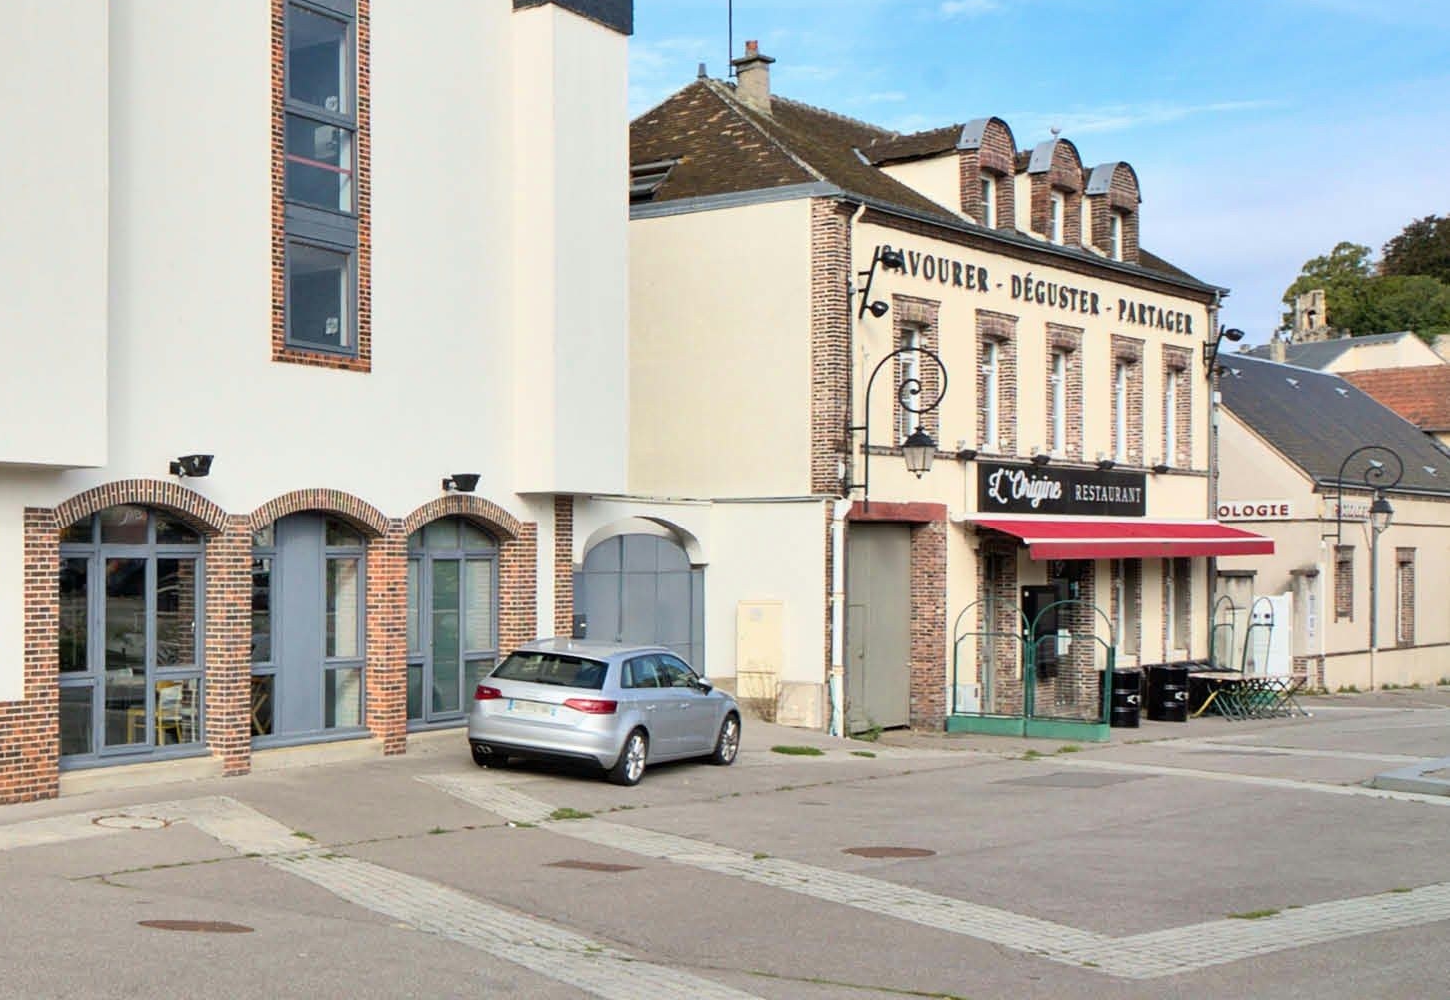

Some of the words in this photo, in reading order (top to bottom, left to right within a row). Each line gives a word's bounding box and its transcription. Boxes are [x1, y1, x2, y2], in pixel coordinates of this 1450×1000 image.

[1011, 272, 1100, 315] DÉGUSTER
[1118, 299, 1193, 335] PARTAGER
[1075, 484, 1142, 503] RESTAURANT
[1217, 504, 1289, 517] OLOGIE
